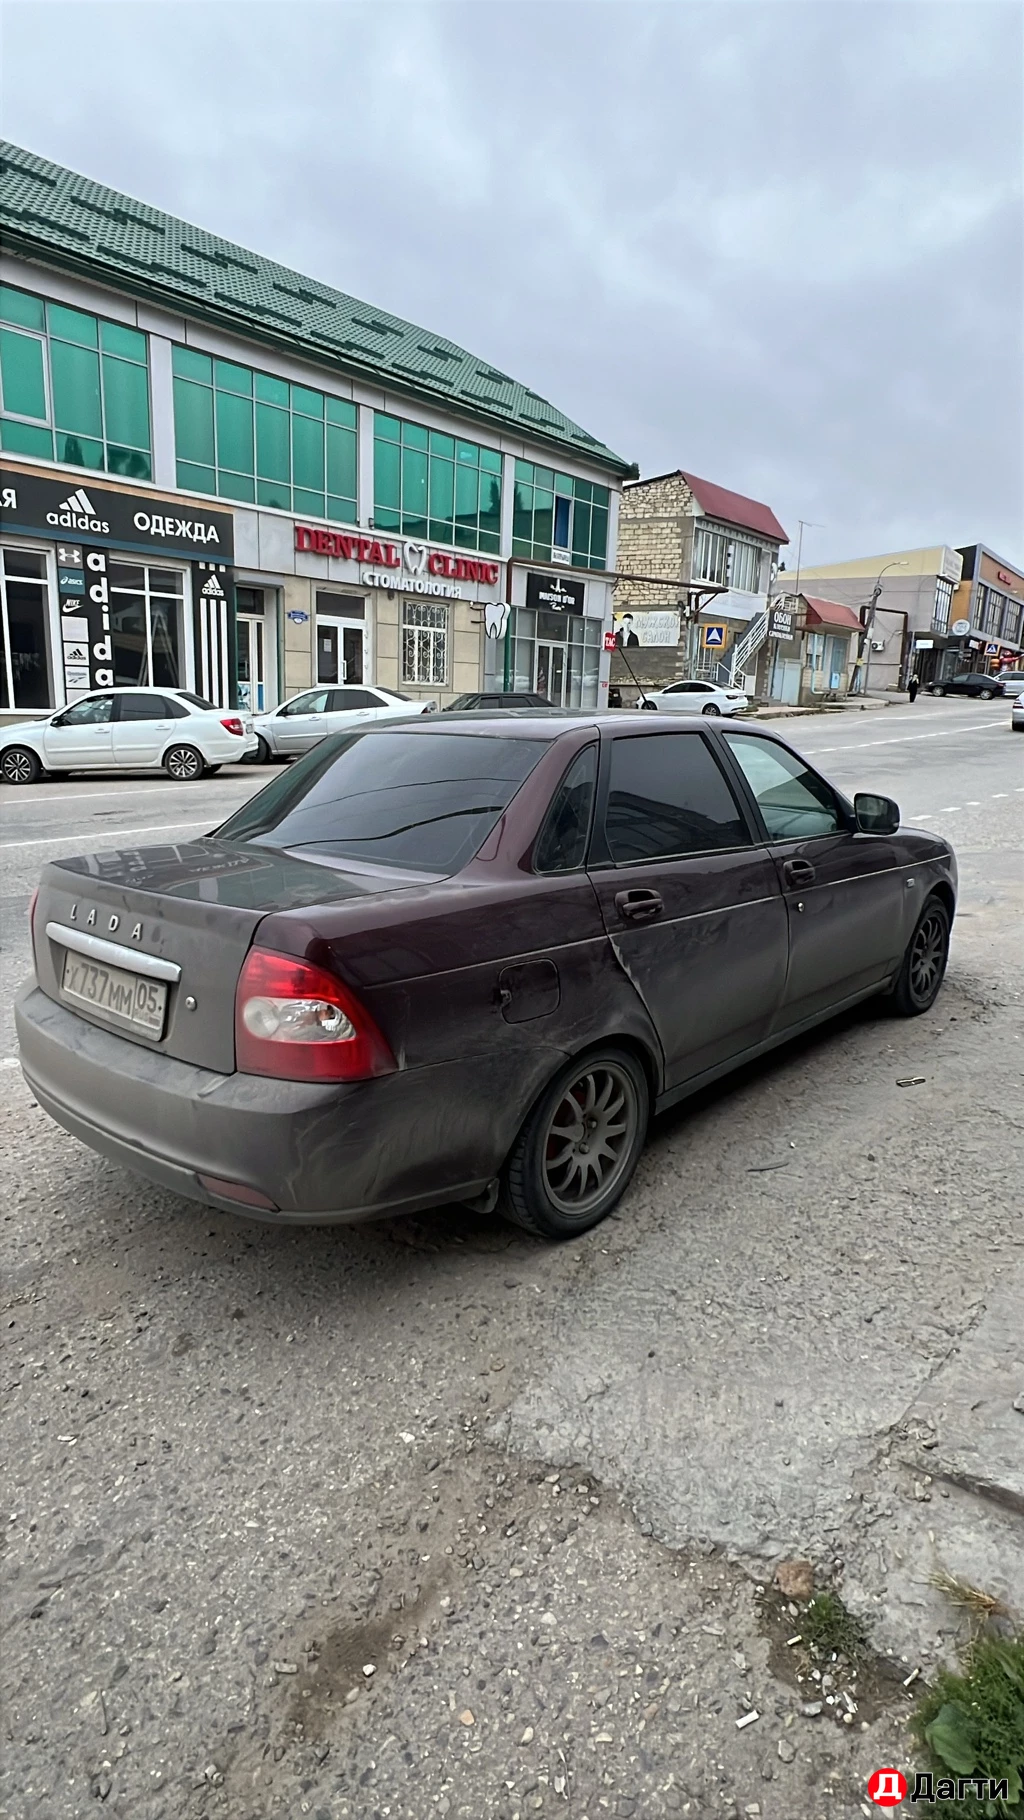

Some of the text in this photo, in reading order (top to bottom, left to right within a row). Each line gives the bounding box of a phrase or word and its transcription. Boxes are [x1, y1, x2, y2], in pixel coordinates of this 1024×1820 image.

[0, 488, 17, 509] Я
[46, 511, 110, 534] adidas
[133, 512, 220, 544] ОДЕЖДА
[294, 526, 499, 584] DENTAL CLINIC
[201, 586, 225, 598] adidas
[362, 572, 462, 599] СТОМАТОЛОГИЯ
[86, 552, 114, 686] adida
[70, 904, 143, 941] LADA
